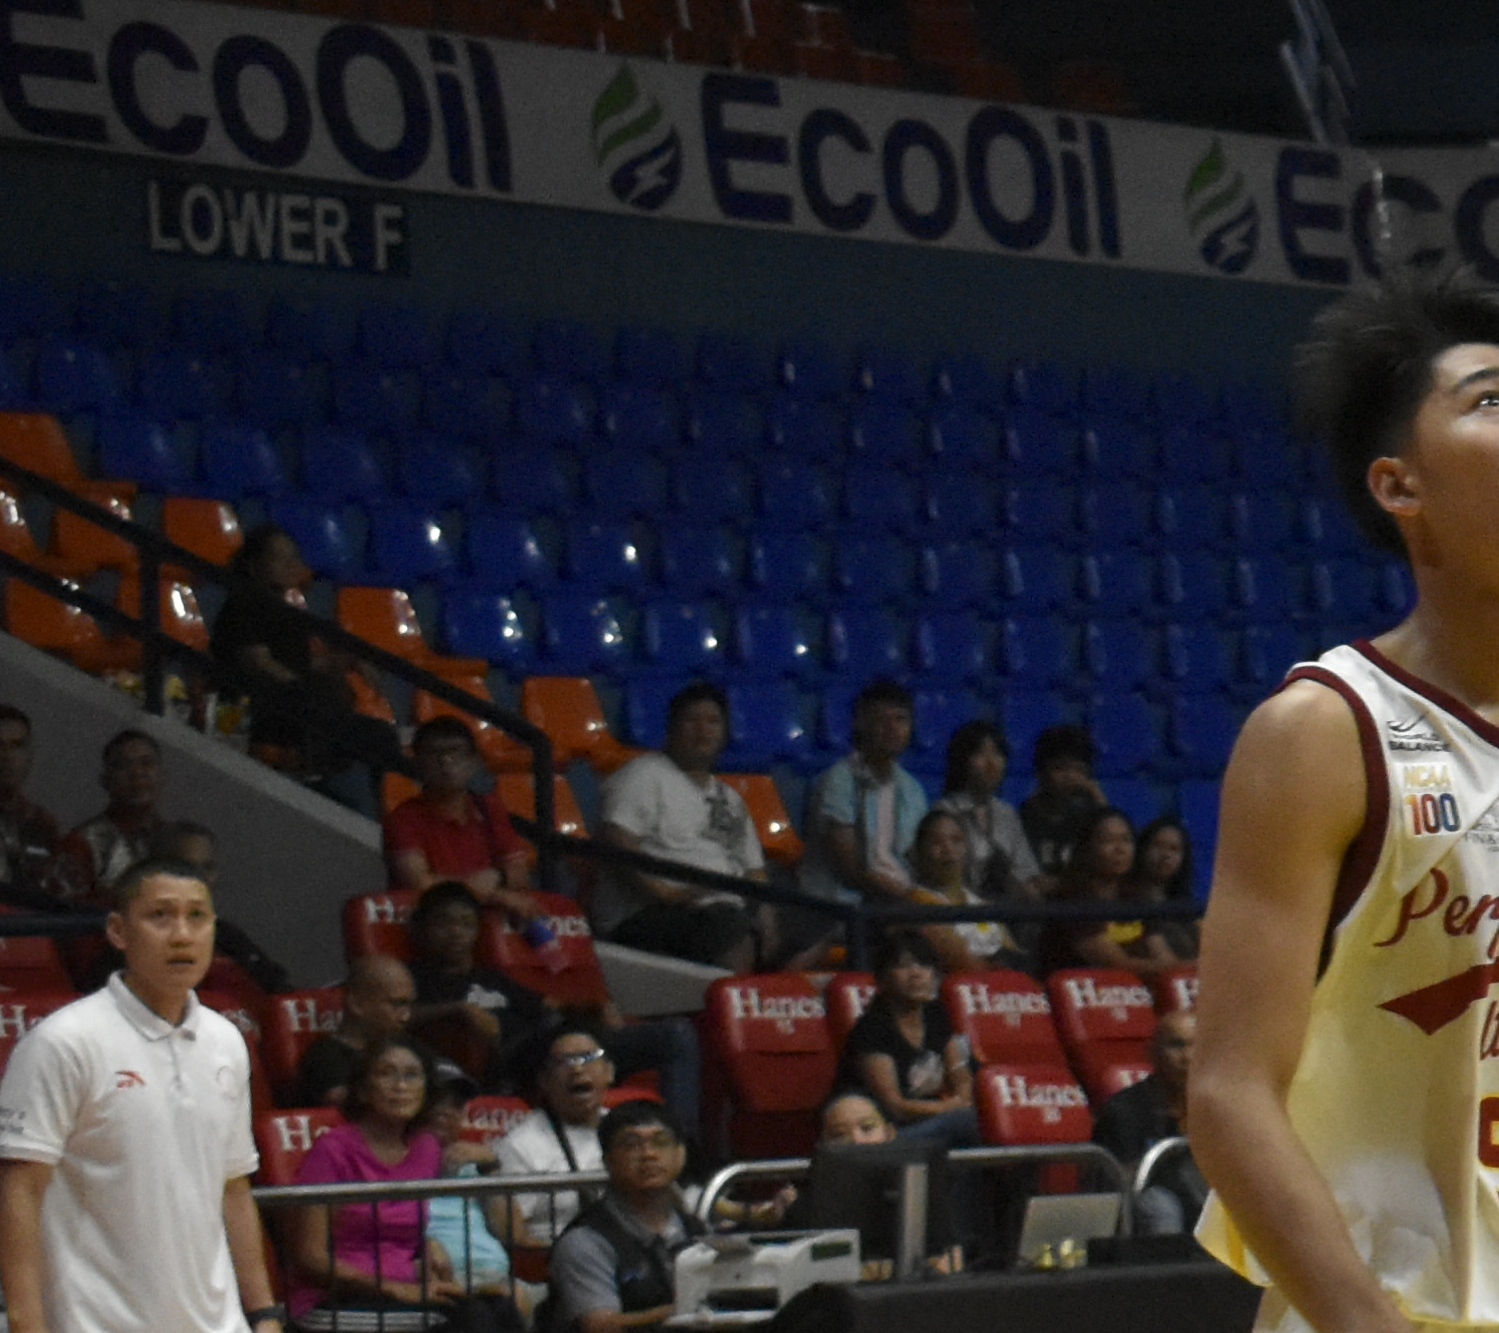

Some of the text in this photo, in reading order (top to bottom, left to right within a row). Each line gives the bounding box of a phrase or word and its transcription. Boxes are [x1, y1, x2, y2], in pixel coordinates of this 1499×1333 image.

[701, 75, 1123, 260] EcoOil
[147, 180, 405, 272] LOWER F
[1389, 740, 1450, 753] BALANCE
[1405, 792, 1461, 836] 100
[726, 985, 827, 1020] Hanes
[956, 983, 1051, 1016] Hanes
[1066, 977, 1155, 1010] Hanes
[994, 1074, 1087, 1109] Hanes
